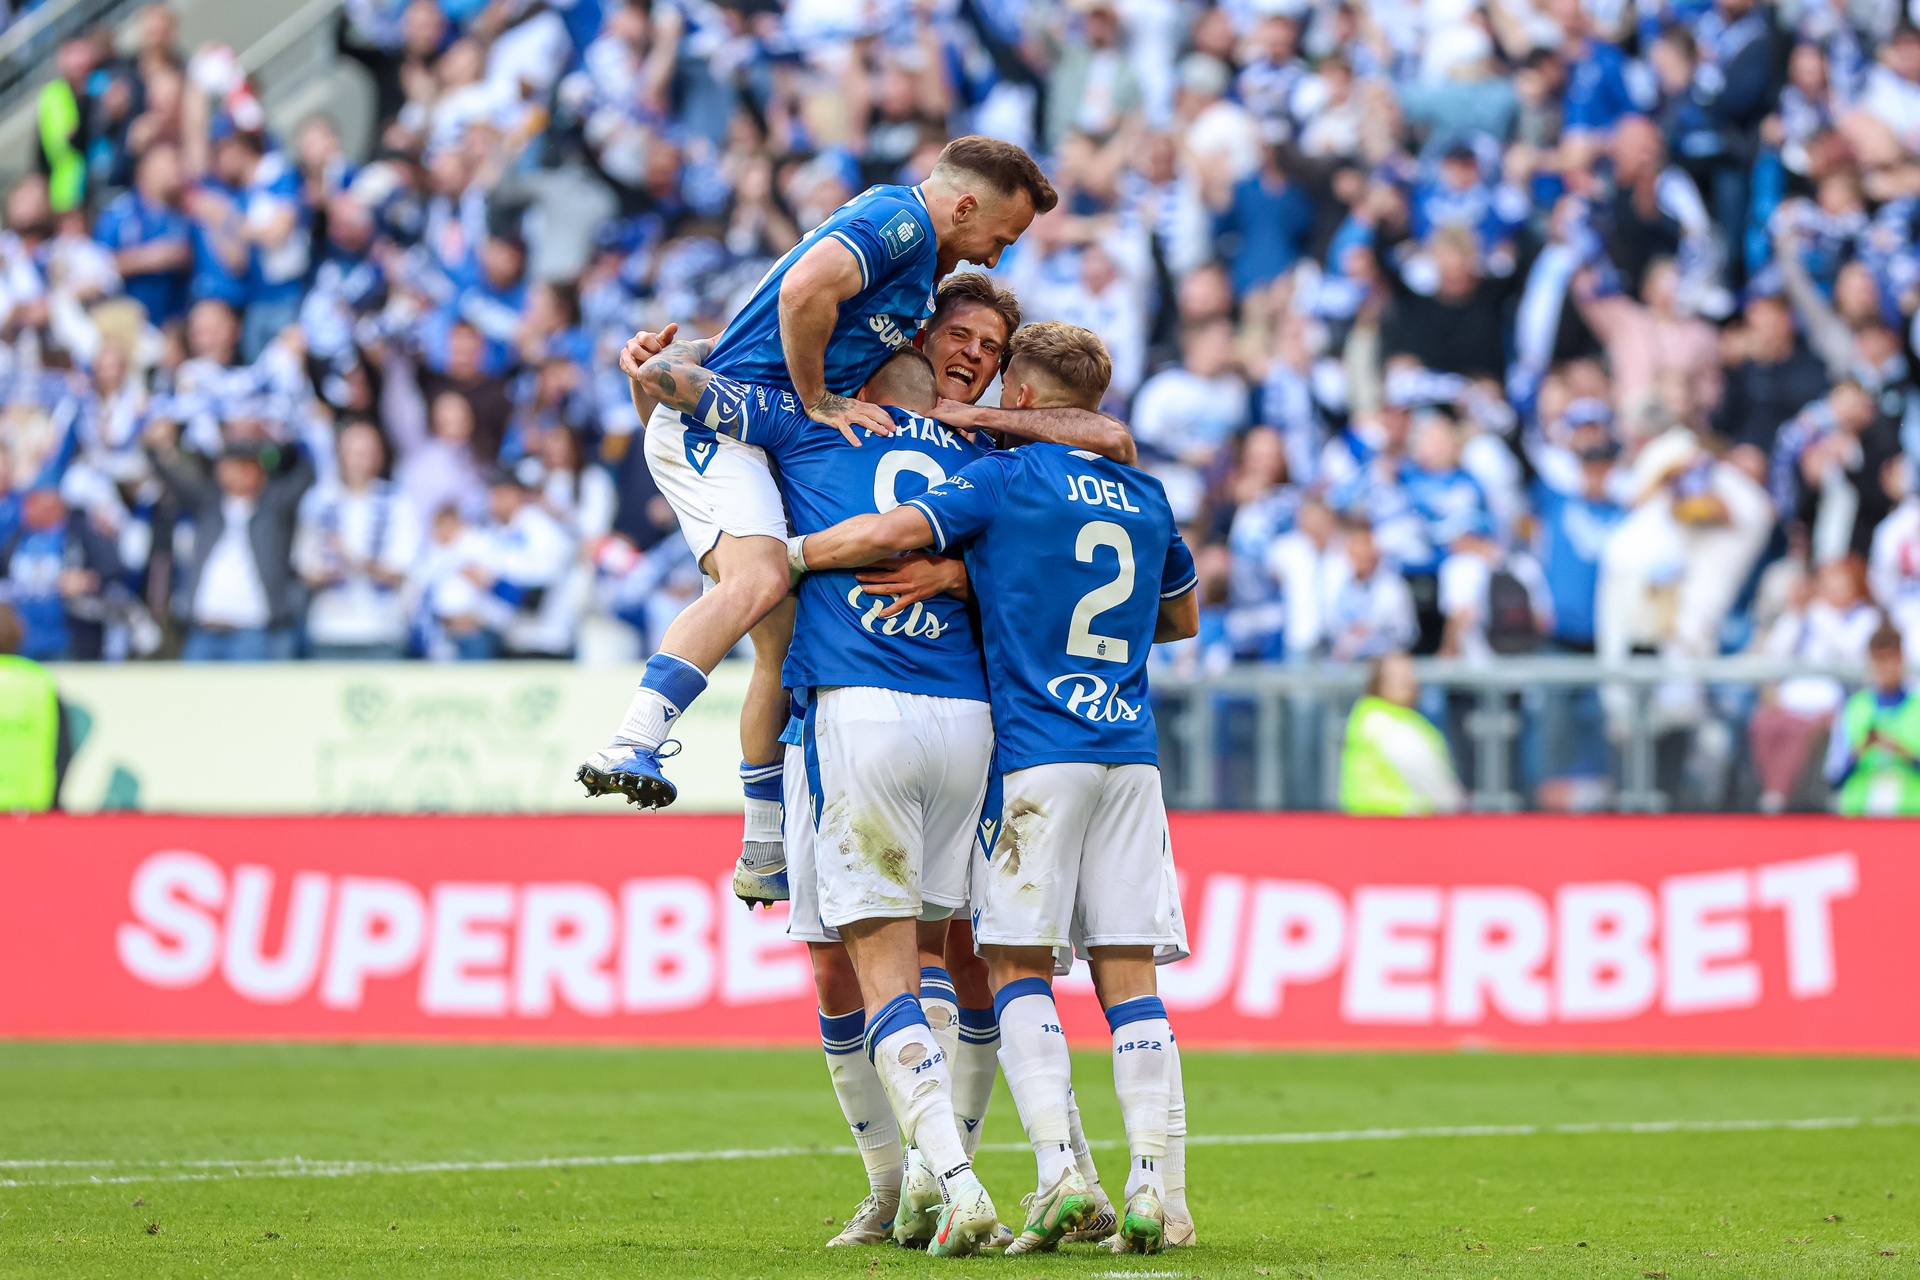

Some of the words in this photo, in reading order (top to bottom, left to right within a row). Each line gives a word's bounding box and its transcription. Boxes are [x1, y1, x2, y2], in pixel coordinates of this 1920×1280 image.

[1066, 474, 1141, 514] JOEL
[1066, 520, 1136, 664] 2
[1046, 673, 1142, 723] Pils
[116, 848, 810, 1019] SUPERBE
[1054, 852, 1860, 1026] UPERBET
[1041, 1023, 1065, 1035] 19
[1116, 1040, 1162, 1055] 1922
[911, 1053, 943, 1075] 192
